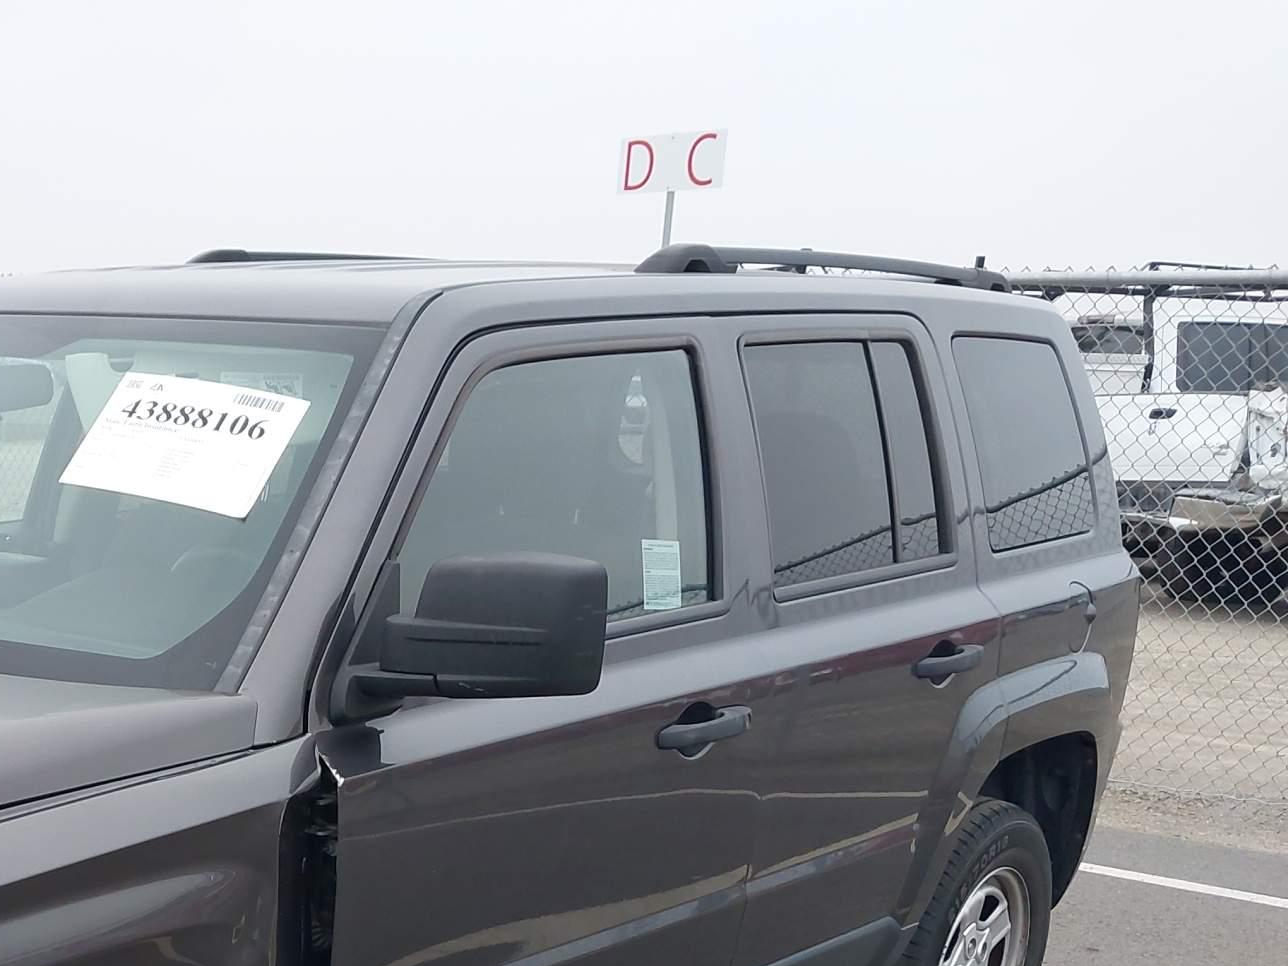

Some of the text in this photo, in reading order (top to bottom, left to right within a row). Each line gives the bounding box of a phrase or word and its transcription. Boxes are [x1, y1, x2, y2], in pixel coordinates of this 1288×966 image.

[623, 133, 717, 191] D C
[121, 398, 271, 440] 43888106
